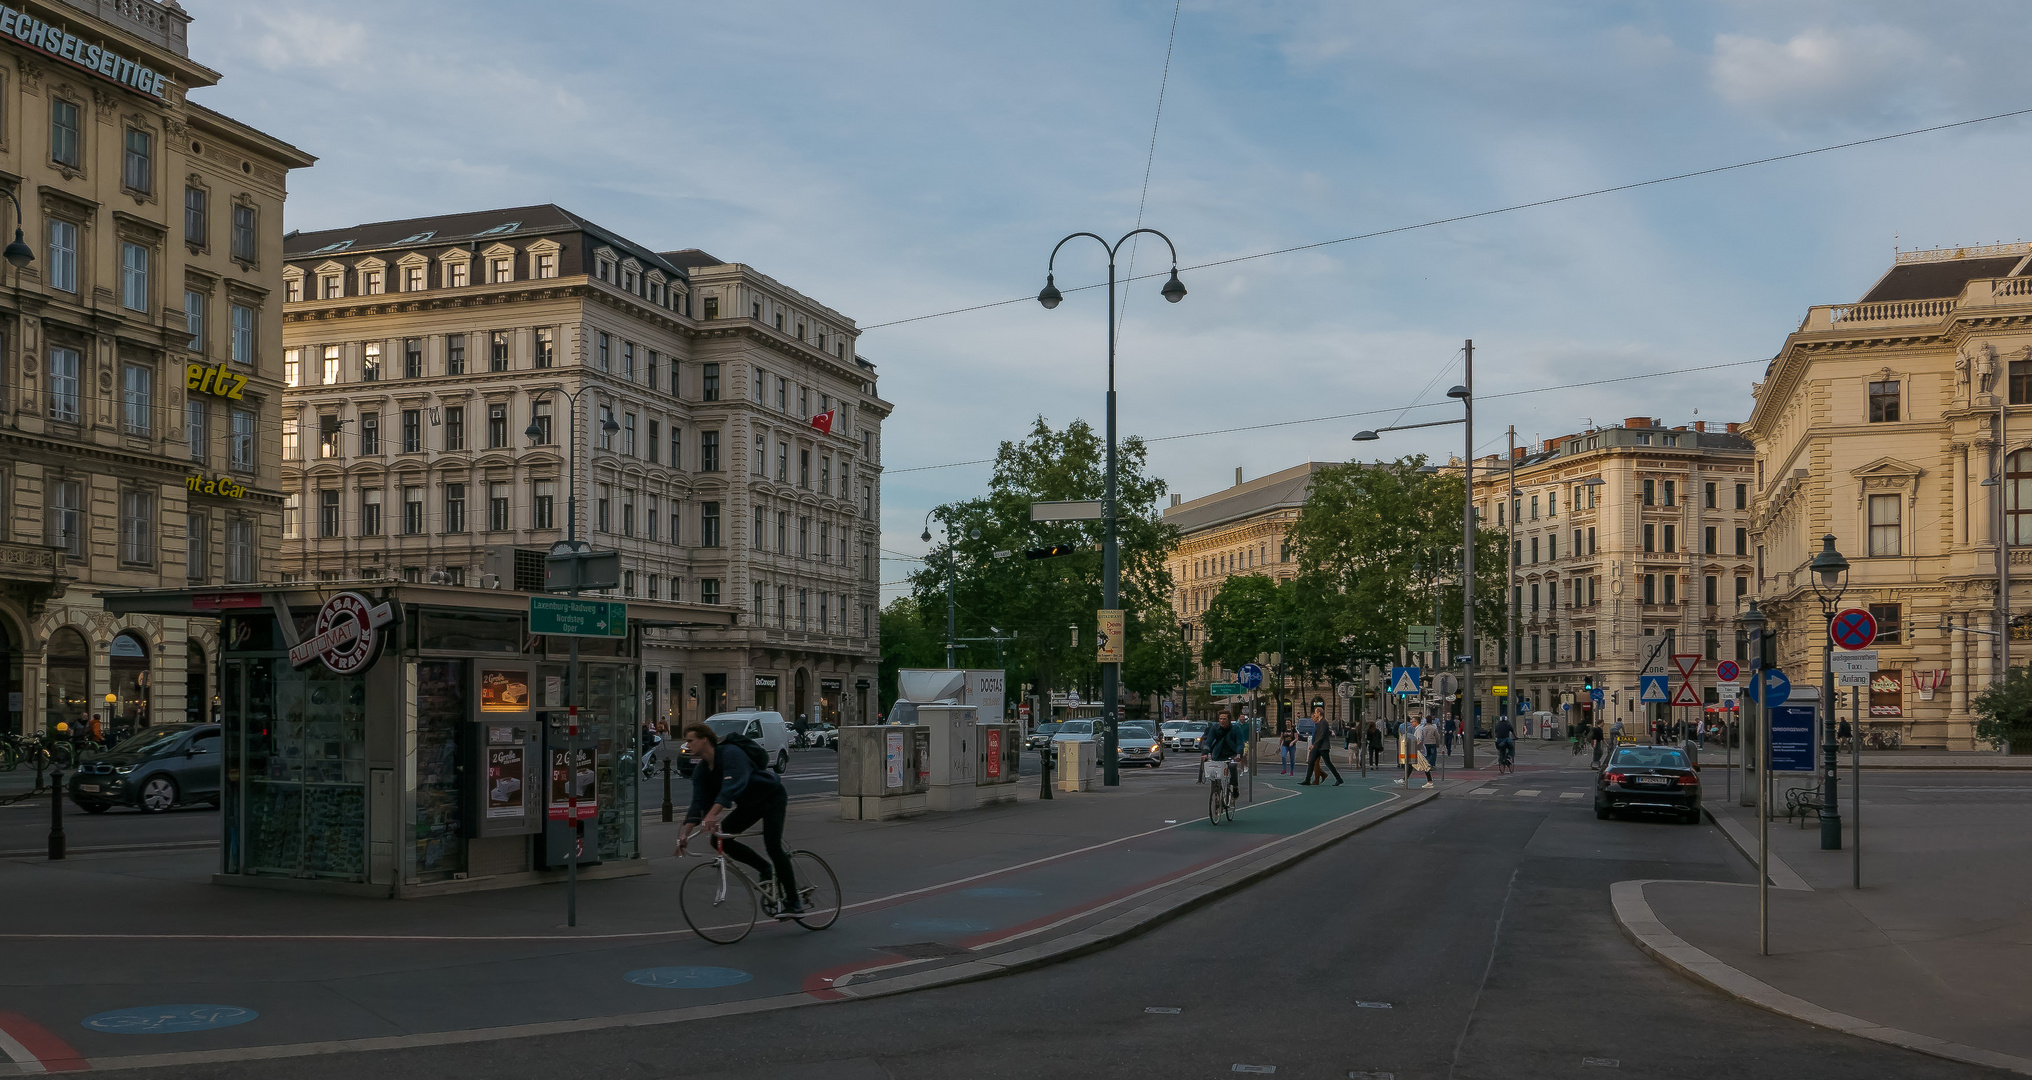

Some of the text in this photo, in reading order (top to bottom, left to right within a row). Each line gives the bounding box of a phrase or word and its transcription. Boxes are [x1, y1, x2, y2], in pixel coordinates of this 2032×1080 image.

[204, 480, 215, 494] a
[218, 478, 247, 498] Car
[534, 600, 595, 614] Laxenburg-Radweg
[321, 597, 362, 629] TABAK
[556, 614, 584, 624] Nordsteg
[563, 624, 577, 632] Oper
[291, 621, 353, 663] AUTOMAT
[330, 628, 370, 668] TRAFIK
[1647, 644, 1661, 658] 30
[1833, 654, 1877, 662] ausgenommen
[1644, 665, 1664, 673] one
[756, 678, 776, 688] BoConcept
[1841, 675, 1866, 684] Anfang
[493, 754, 498, 763] 2
[556, 753, 563, 766] 2
